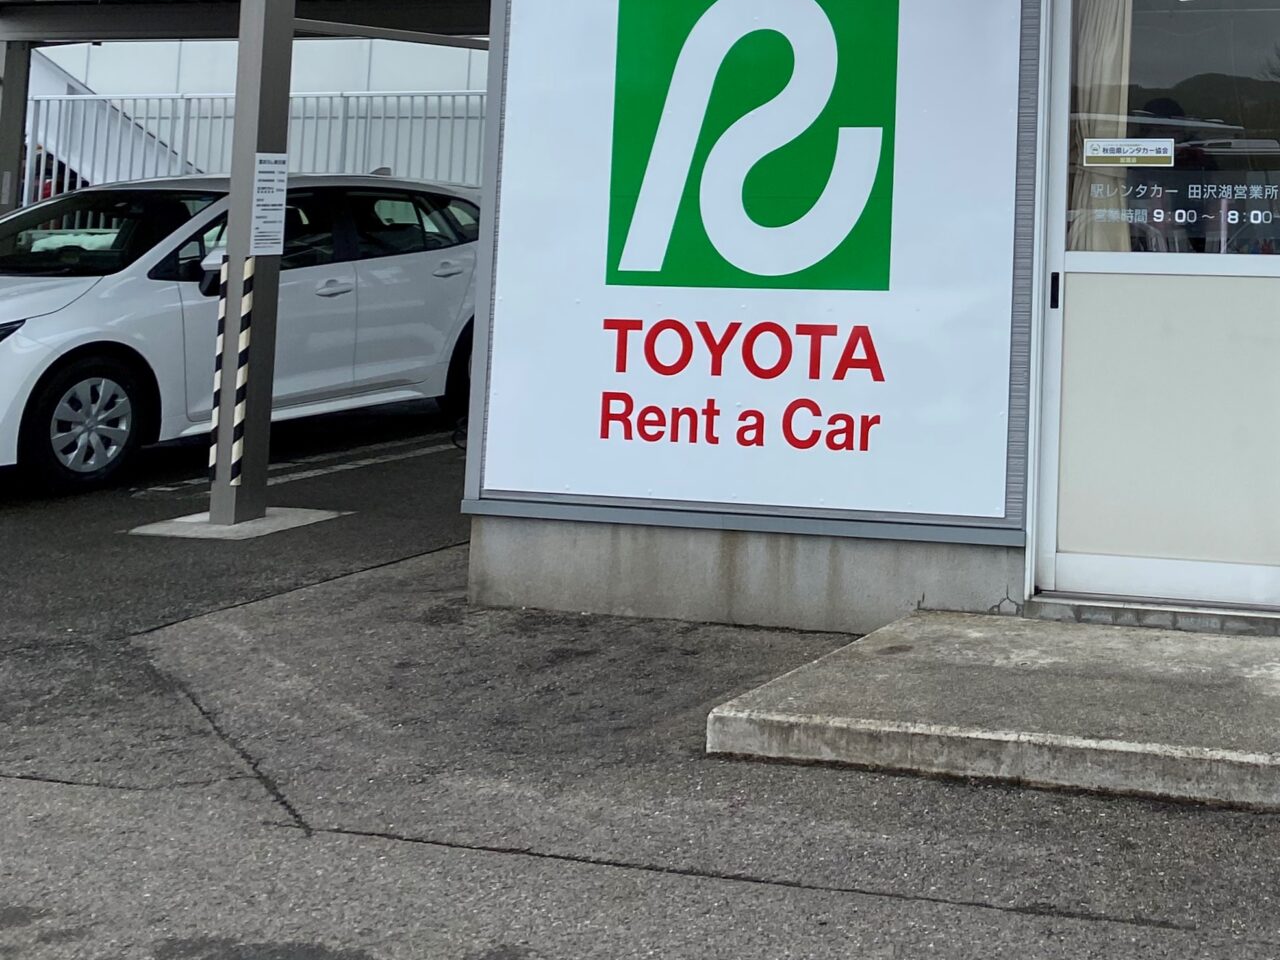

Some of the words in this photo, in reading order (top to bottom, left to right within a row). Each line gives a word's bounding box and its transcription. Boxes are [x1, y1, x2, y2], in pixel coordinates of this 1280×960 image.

[1090, 183, 1179, 200] 駅レンタカー
[1187, 184, 1279, 200] 田沢湖営業所
[603, 318, 886, 382] TOYOTA
[599, 391, 721, 445] Rent
[736, 407, 765, 447] a
[781, 397, 881, 452] Car
